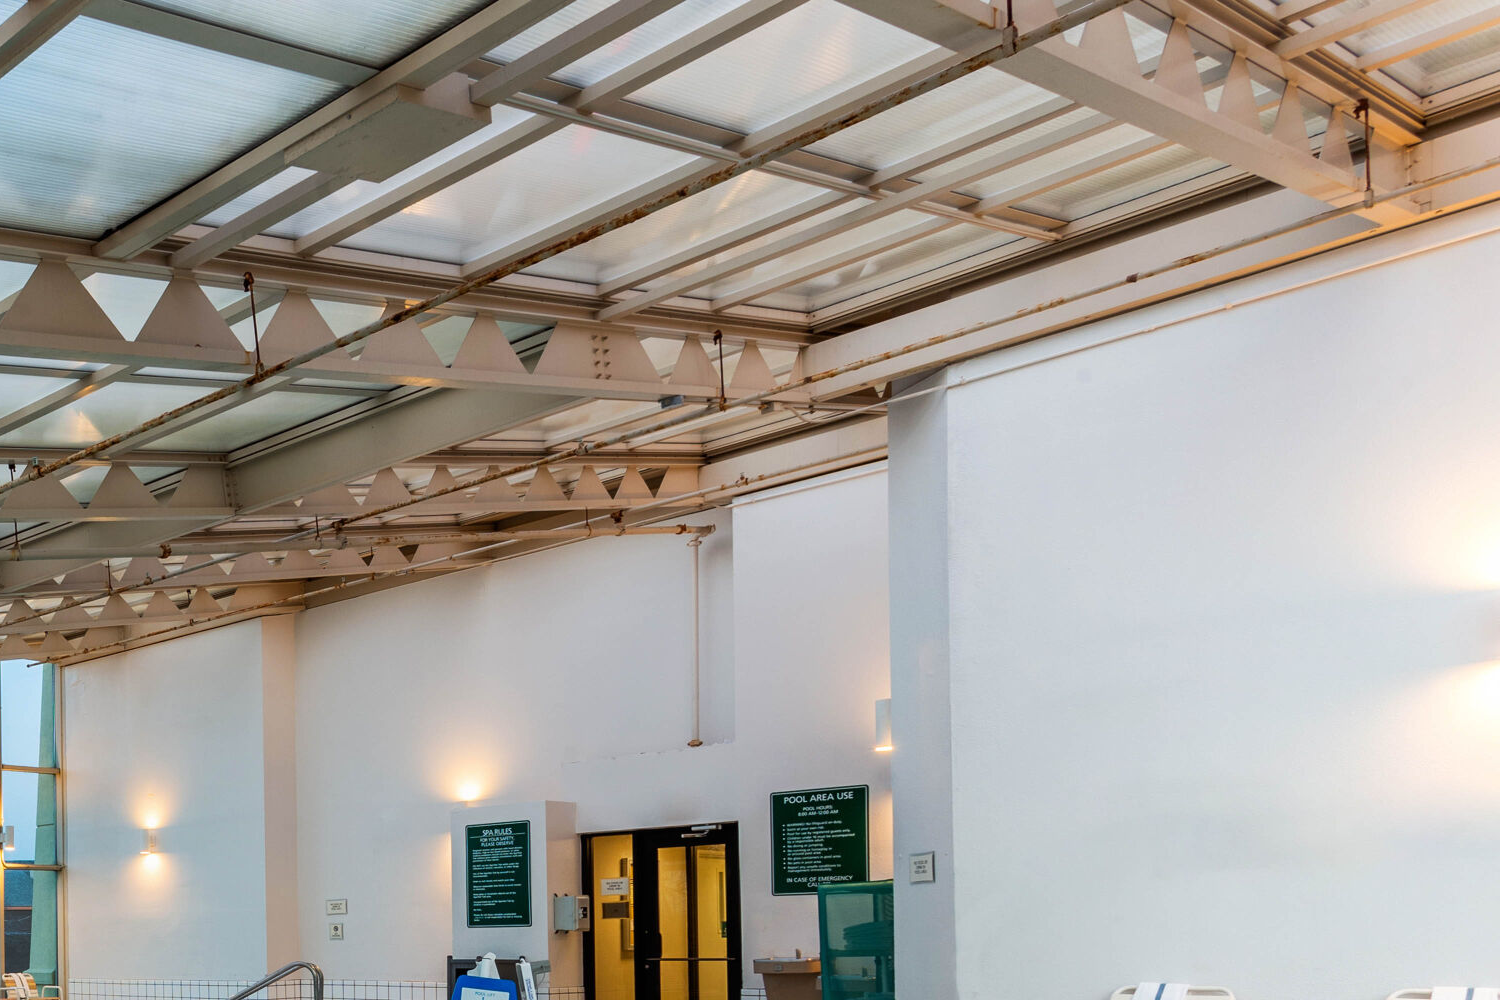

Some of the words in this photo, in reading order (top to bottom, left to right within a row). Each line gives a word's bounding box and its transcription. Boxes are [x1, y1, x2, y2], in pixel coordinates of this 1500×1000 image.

[783, 796, 807, 804] POOL
[809, 793, 834, 802] AREA
[836, 791, 853, 799] USE
[494, 827, 513, 836] RULES
[817, 874, 854, 882] EMERGENCY
